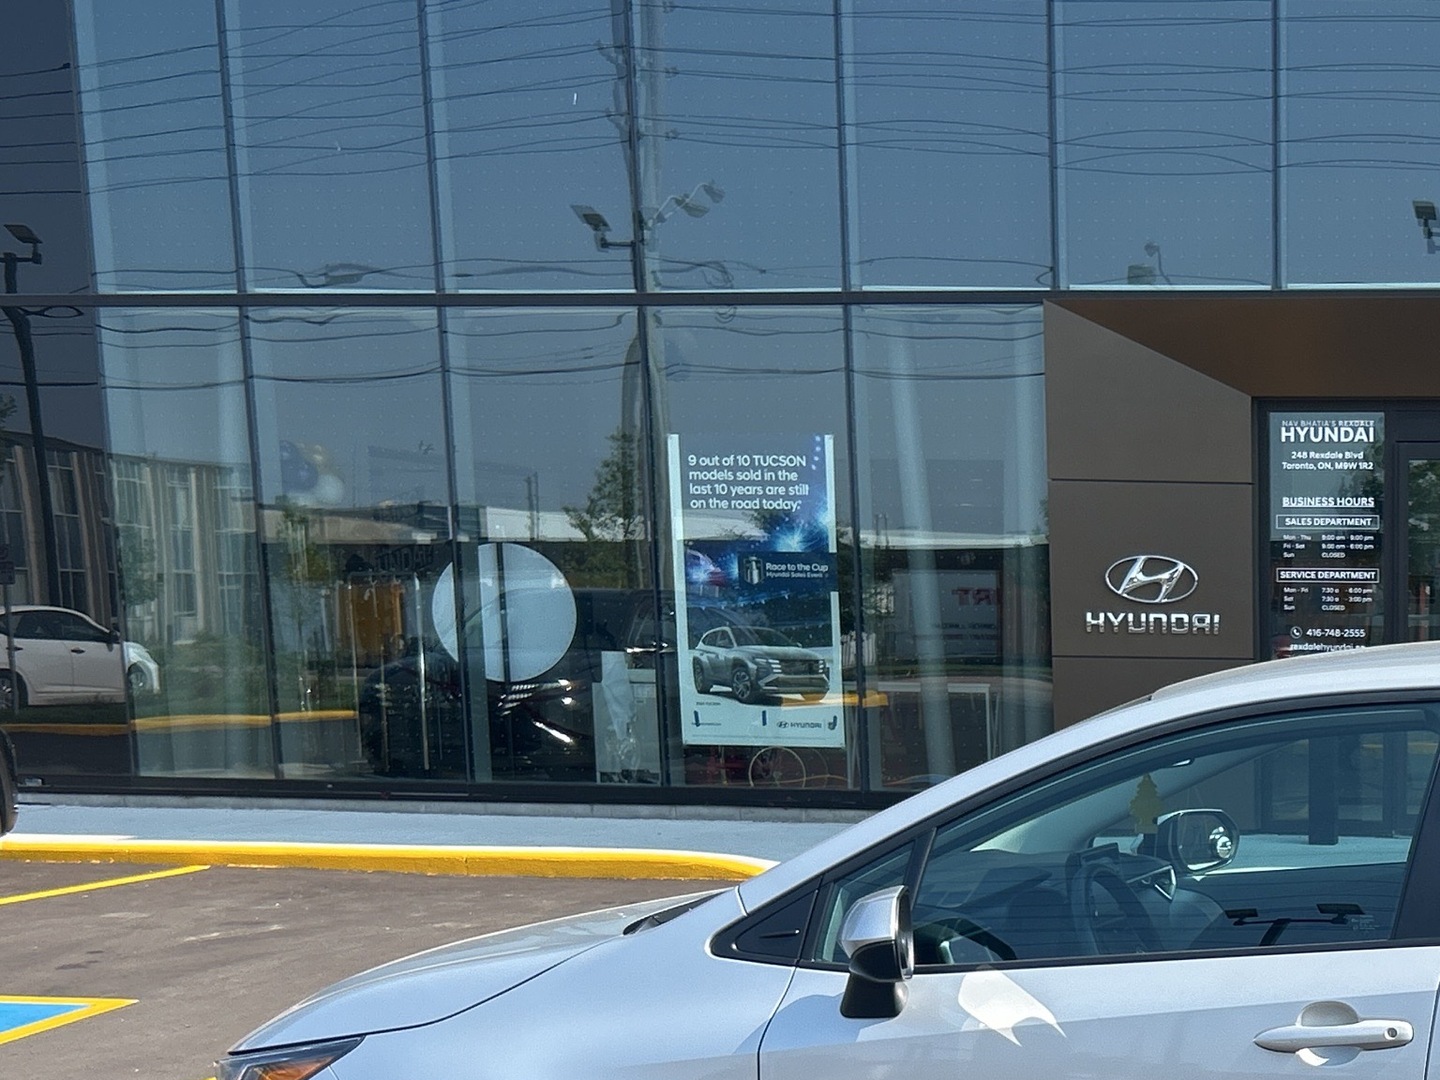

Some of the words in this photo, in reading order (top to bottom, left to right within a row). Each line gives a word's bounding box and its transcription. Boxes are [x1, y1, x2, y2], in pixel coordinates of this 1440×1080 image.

[1281, 426, 1374, 443] HYUNDAI
[688, 454, 697, 466] 9
[699, 455, 720, 466] out
[722, 455, 735, 466] of
[737, 455, 750, 466] 10
[753, 455, 806, 466] TUCSON
[1291, 451, 1308, 459] 248
[1309, 451, 1343, 459] Rexdale
[1344, 451, 1364, 459] Blvd
[1282, 462, 1317, 470] Toronto,
[1335, 462, 1358, 470] M9W
[1358, 462, 1374, 470] 1R2
[689, 469, 734, 480] models
[736, 469, 761, 480] sold
[764, 469, 775, 480] in
[778, 470, 798, 481] the
[689, 483, 712, 494] last
[714, 484, 728, 495] 10
[730, 485, 763, 496] years
[765, 486, 786, 495] are
[788, 484, 809, 496] still
[690, 499, 706, 509] on
[708, 498, 729, 509] the
[731, 498, 760, 509] road
[1282, 497, 1335, 507] BUSINESS
[1337, 497, 1375, 507] HOURS
[1285, 518, 1312, 526] SALES
[1313, 518, 1372, 526] DEPARTMENT
[765, 562, 786, 571] Race
[787, 563, 796, 571] to
[797, 563, 810, 571] the
[811, 563, 829, 573] Cup
[1280, 571, 1316, 579] SERVICE
[1318, 571, 1376, 579] DEPARTMENT
[1086, 611, 1220, 635] HYUNDAI
[1306, 629, 1366, 638] 416-748-2555
